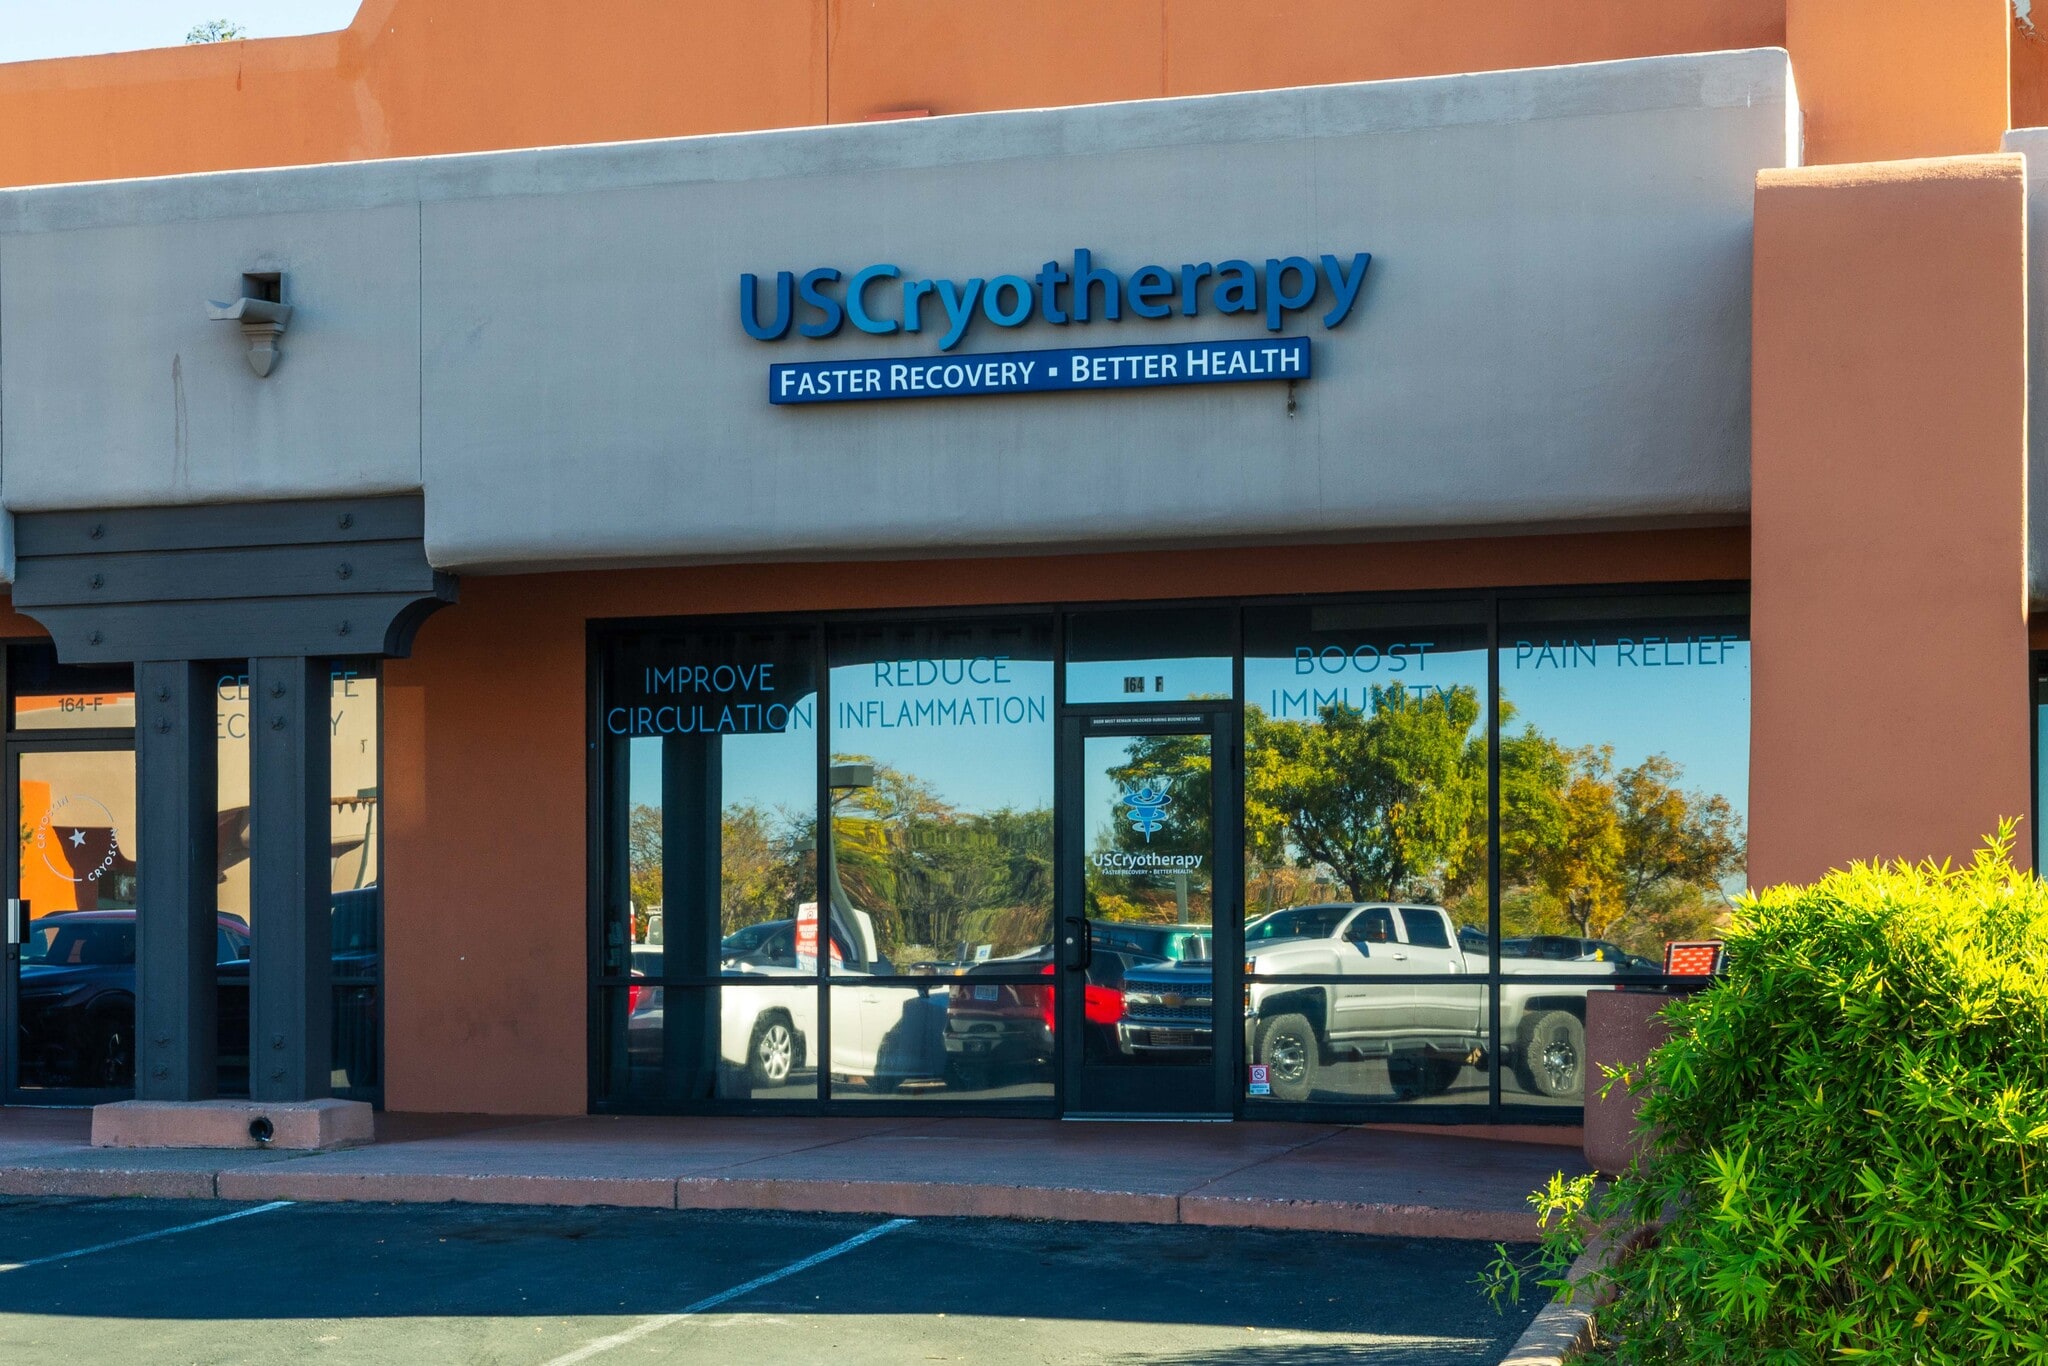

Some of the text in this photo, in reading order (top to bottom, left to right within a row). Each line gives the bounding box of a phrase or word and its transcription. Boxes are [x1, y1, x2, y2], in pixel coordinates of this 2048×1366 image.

[740, 247, 1371, 351] USCryotherapy
[781, 347, 1300, 396] FASTER RECOVERY BETTER HEALTH
[1295, 642, 1434, 675] BOOST
[1516, 635, 1738, 669] PAIN RELIEF
[646, 664, 775, 694] IMPROVE
[875, 655, 1011, 687] REDUCE
[1124, 676, 1163, 693] 164 F
[58, 697, 103, 712] 164-F
[839, 695, 1045, 729] INFLAMMATION
[1273, 684, 1457, 717] IMMUNITY
[607, 702, 812, 735] CIRCULATION
[1093, 852, 1203, 869] USCryotherapy
